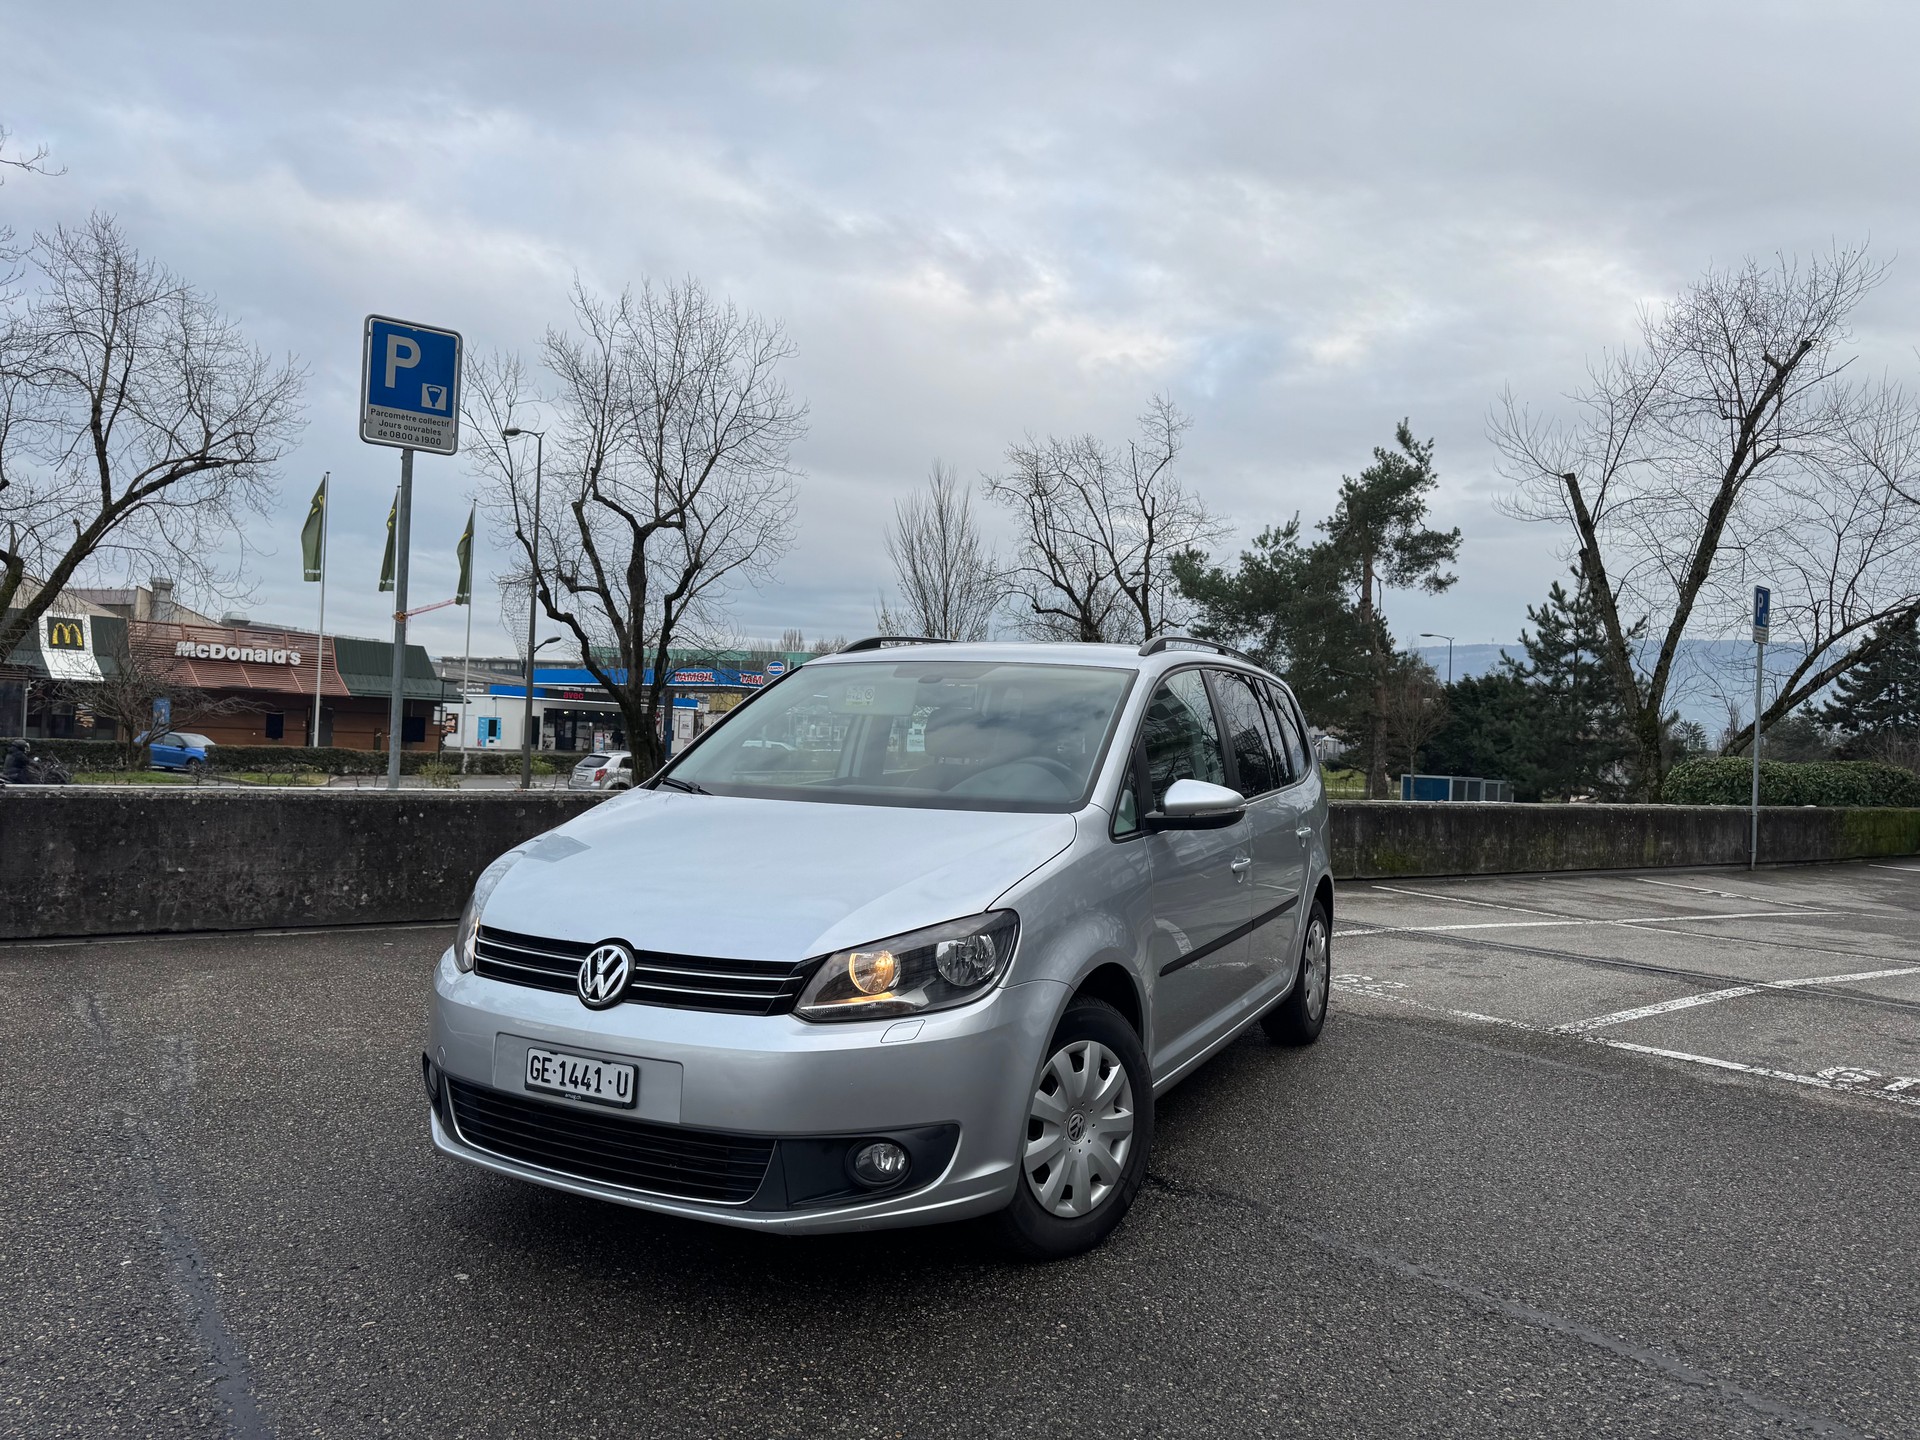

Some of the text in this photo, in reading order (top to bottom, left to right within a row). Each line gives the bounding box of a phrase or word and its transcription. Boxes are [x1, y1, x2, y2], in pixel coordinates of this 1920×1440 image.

[385, 334, 422, 388] P
[371, 408, 450, 427] Parcomètre collectif
[379, 420, 441, 436] Jours ouvrables
[415, 434, 420, 442] à
[1757, 593, 1764, 617] P
[175, 641, 301, 665] McDonald's
[675, 671, 715, 682] TAMOIL
[563, 691, 584, 699] avec
